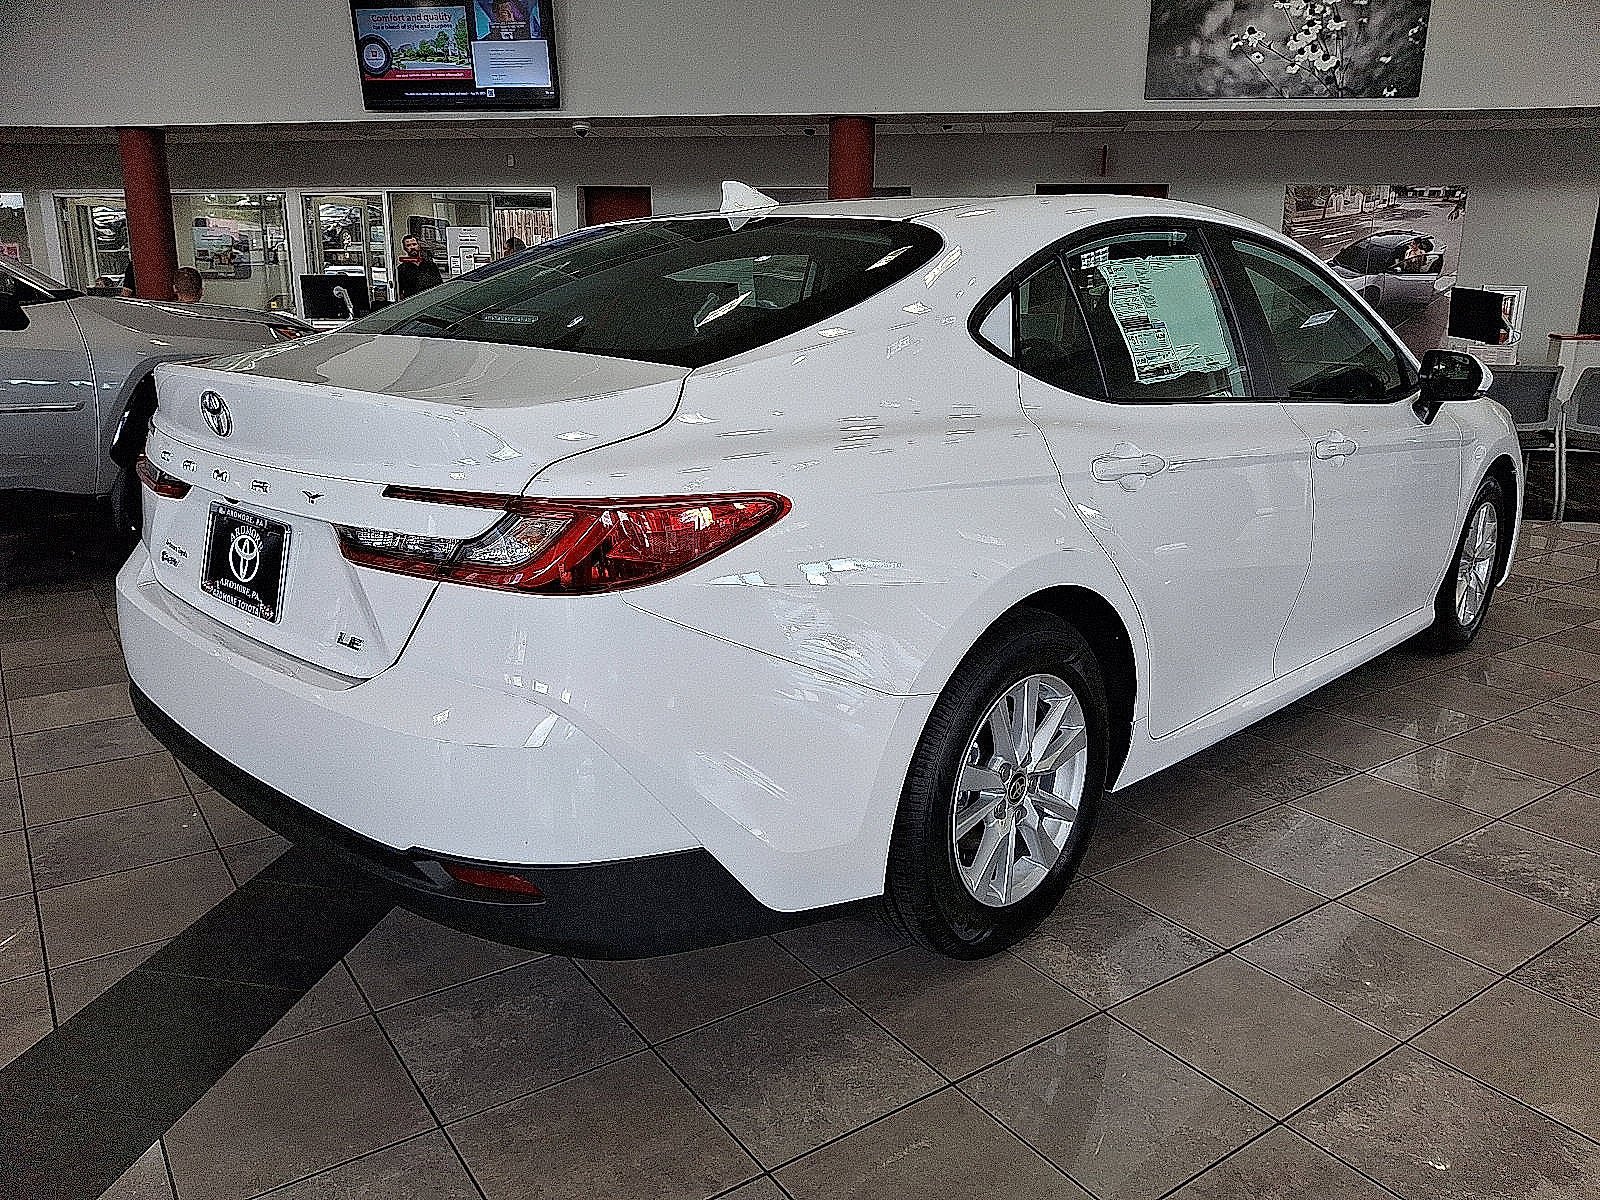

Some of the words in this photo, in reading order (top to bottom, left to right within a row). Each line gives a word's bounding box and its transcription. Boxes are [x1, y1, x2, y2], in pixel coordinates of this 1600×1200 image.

[371, 13, 405, 22] Comfort
[406, 13, 422, 22] and
[423, 12, 452, 22] quality
[407, 23, 420, 31] style
[161, 450, 325, 504] CAMRY
[237, 600, 260, 617] TOYOTA
[337, 631, 363, 651] LE
